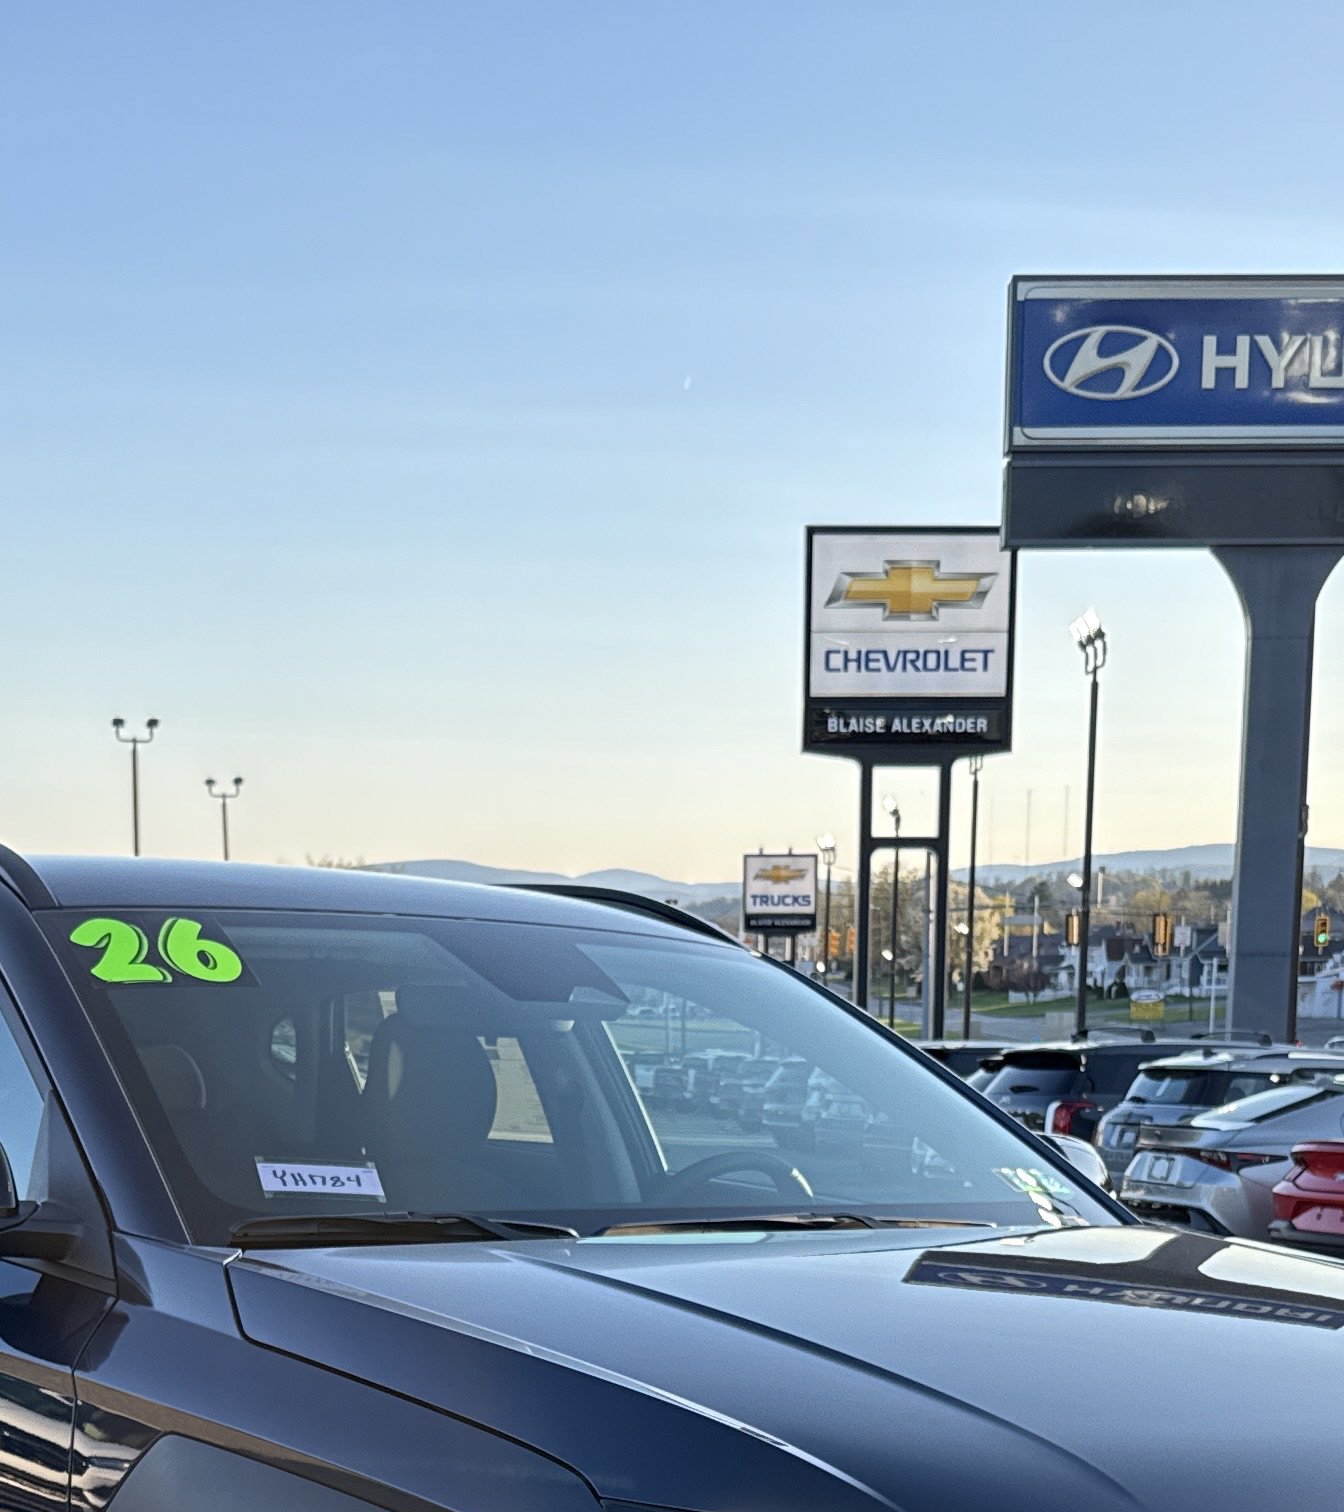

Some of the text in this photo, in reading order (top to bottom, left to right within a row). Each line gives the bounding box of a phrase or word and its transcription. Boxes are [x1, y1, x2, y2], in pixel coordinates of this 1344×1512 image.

[824, 648, 995, 673] CHEVROLET
[827, 715, 989, 734] BLAISE ALEXANDER
[750, 894, 812, 907] TRUCKS
[69, 917, 243, 983] 26
